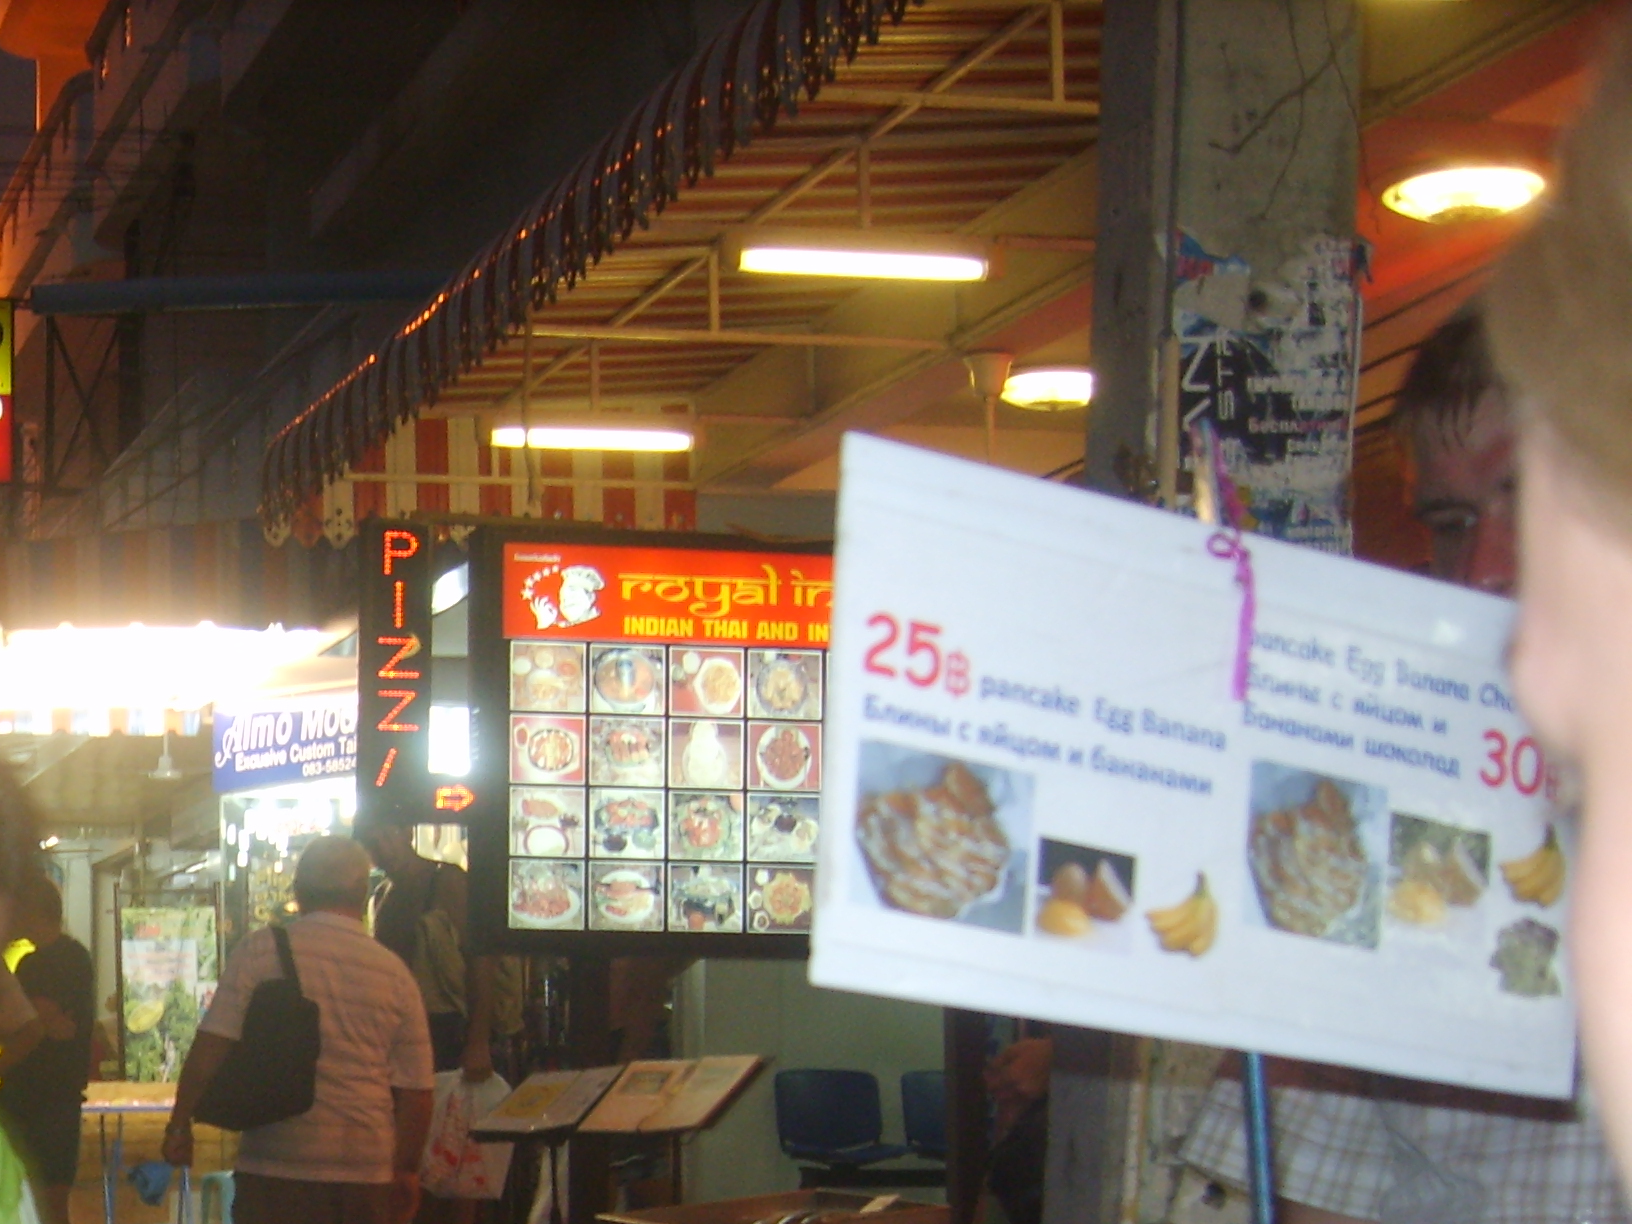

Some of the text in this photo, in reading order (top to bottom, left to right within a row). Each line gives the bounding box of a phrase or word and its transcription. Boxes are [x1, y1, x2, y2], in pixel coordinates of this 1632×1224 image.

[618, 564, 783, 618] royal
[623, 615, 832, 643] INDIAN THAI AND IN
[1396, 657, 1470, 702] Banana
[863, 694, 952, 737] Блины
[979, 674, 1080, 718] pancake
[1094, 696, 1134, 736] Egg
[1141, 708, 1227, 751] Banana
[289, 739, 335, 764] Custom
